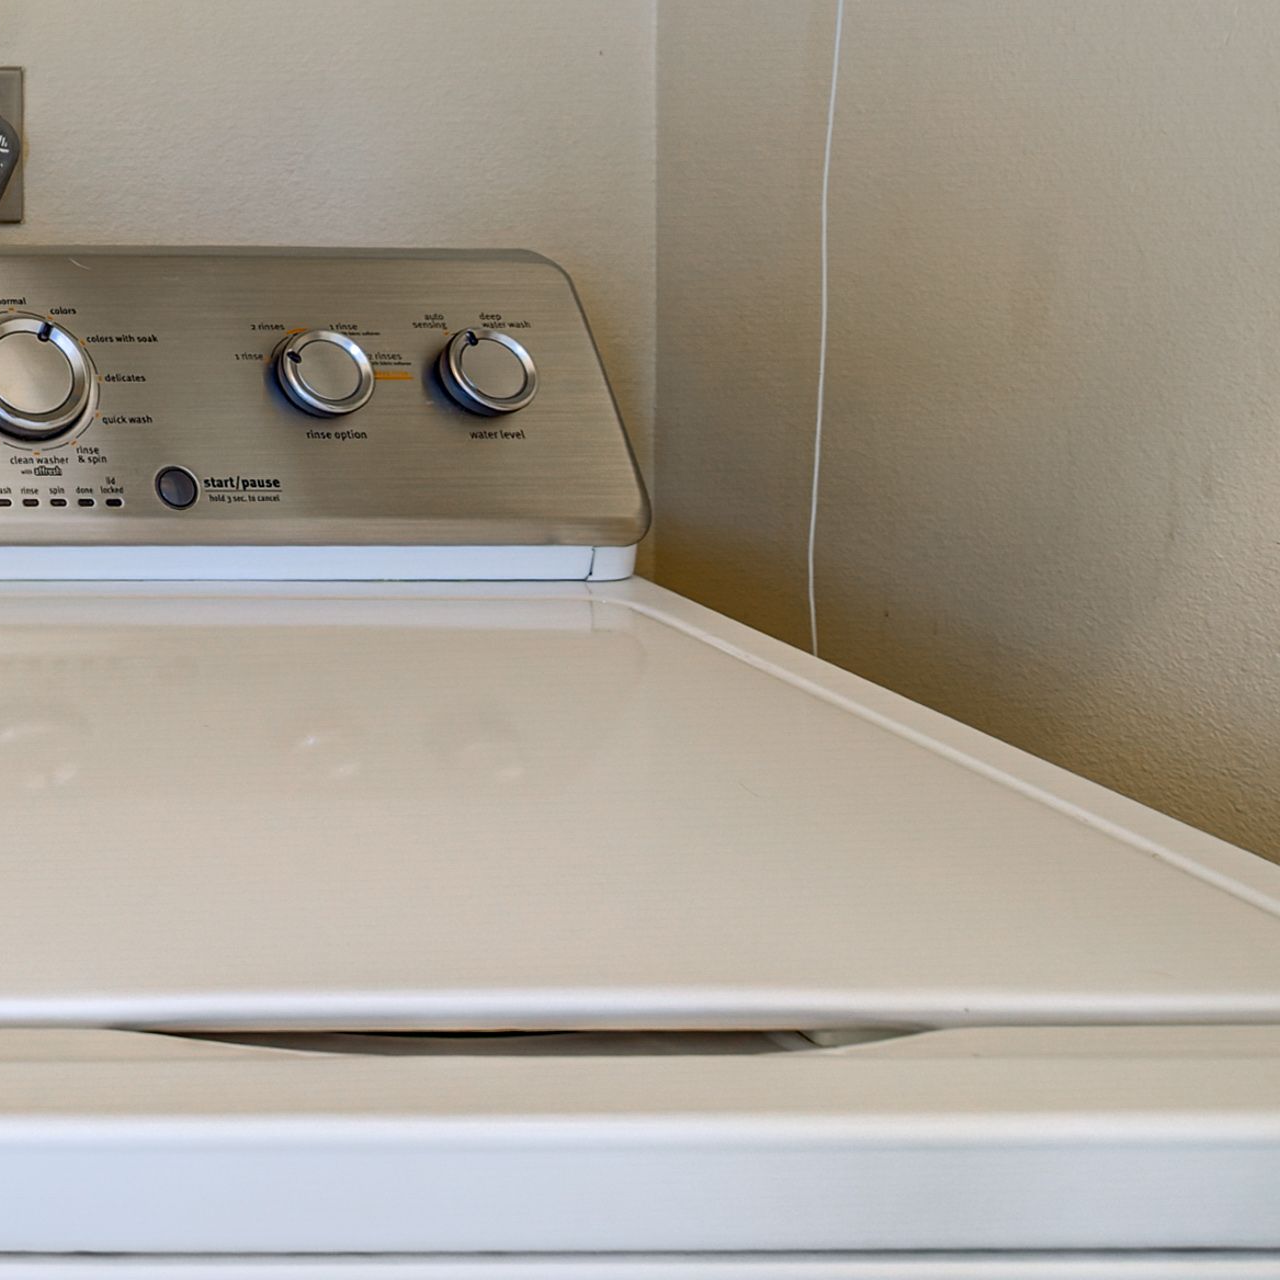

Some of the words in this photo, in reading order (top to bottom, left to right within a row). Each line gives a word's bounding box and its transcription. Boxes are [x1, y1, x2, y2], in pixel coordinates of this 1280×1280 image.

[49, 307, 77, 315] colors
[104, 374, 146, 382] delicates
[102, 415, 127, 425] quick
[128, 415, 152, 424] wash
[307, 429, 333, 440] rinse
[334, 429, 368, 441] option
[469, 430, 498, 440] water
[499, 429, 526, 440] level
[9, 455, 35, 465] clean
[36, 456, 69, 465] washer
[203, 475, 281, 491] start/pause
